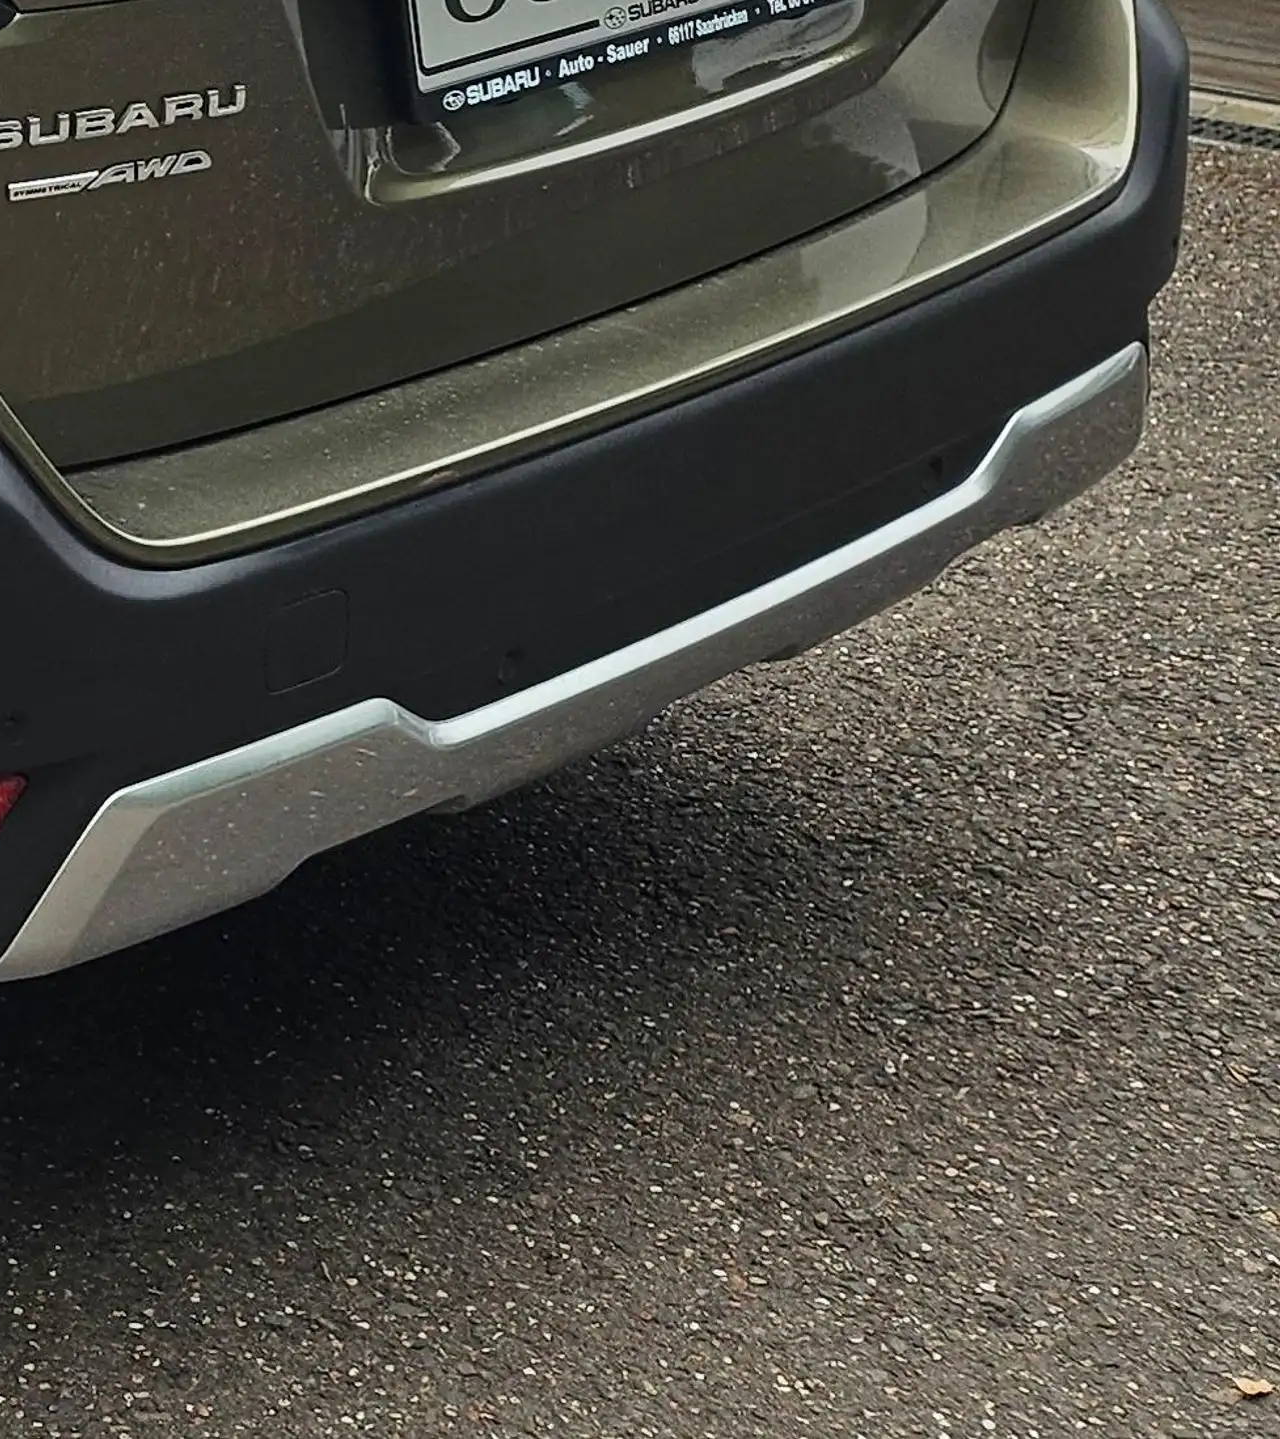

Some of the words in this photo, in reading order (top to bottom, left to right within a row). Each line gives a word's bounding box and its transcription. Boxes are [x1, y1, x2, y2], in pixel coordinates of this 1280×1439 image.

[466, 66, 540, 106] SUBARU
[558, 57, 594, 78] Auto
[606, 37, 649, 63] Sauer
[86, 149, 213, 190] AWD
